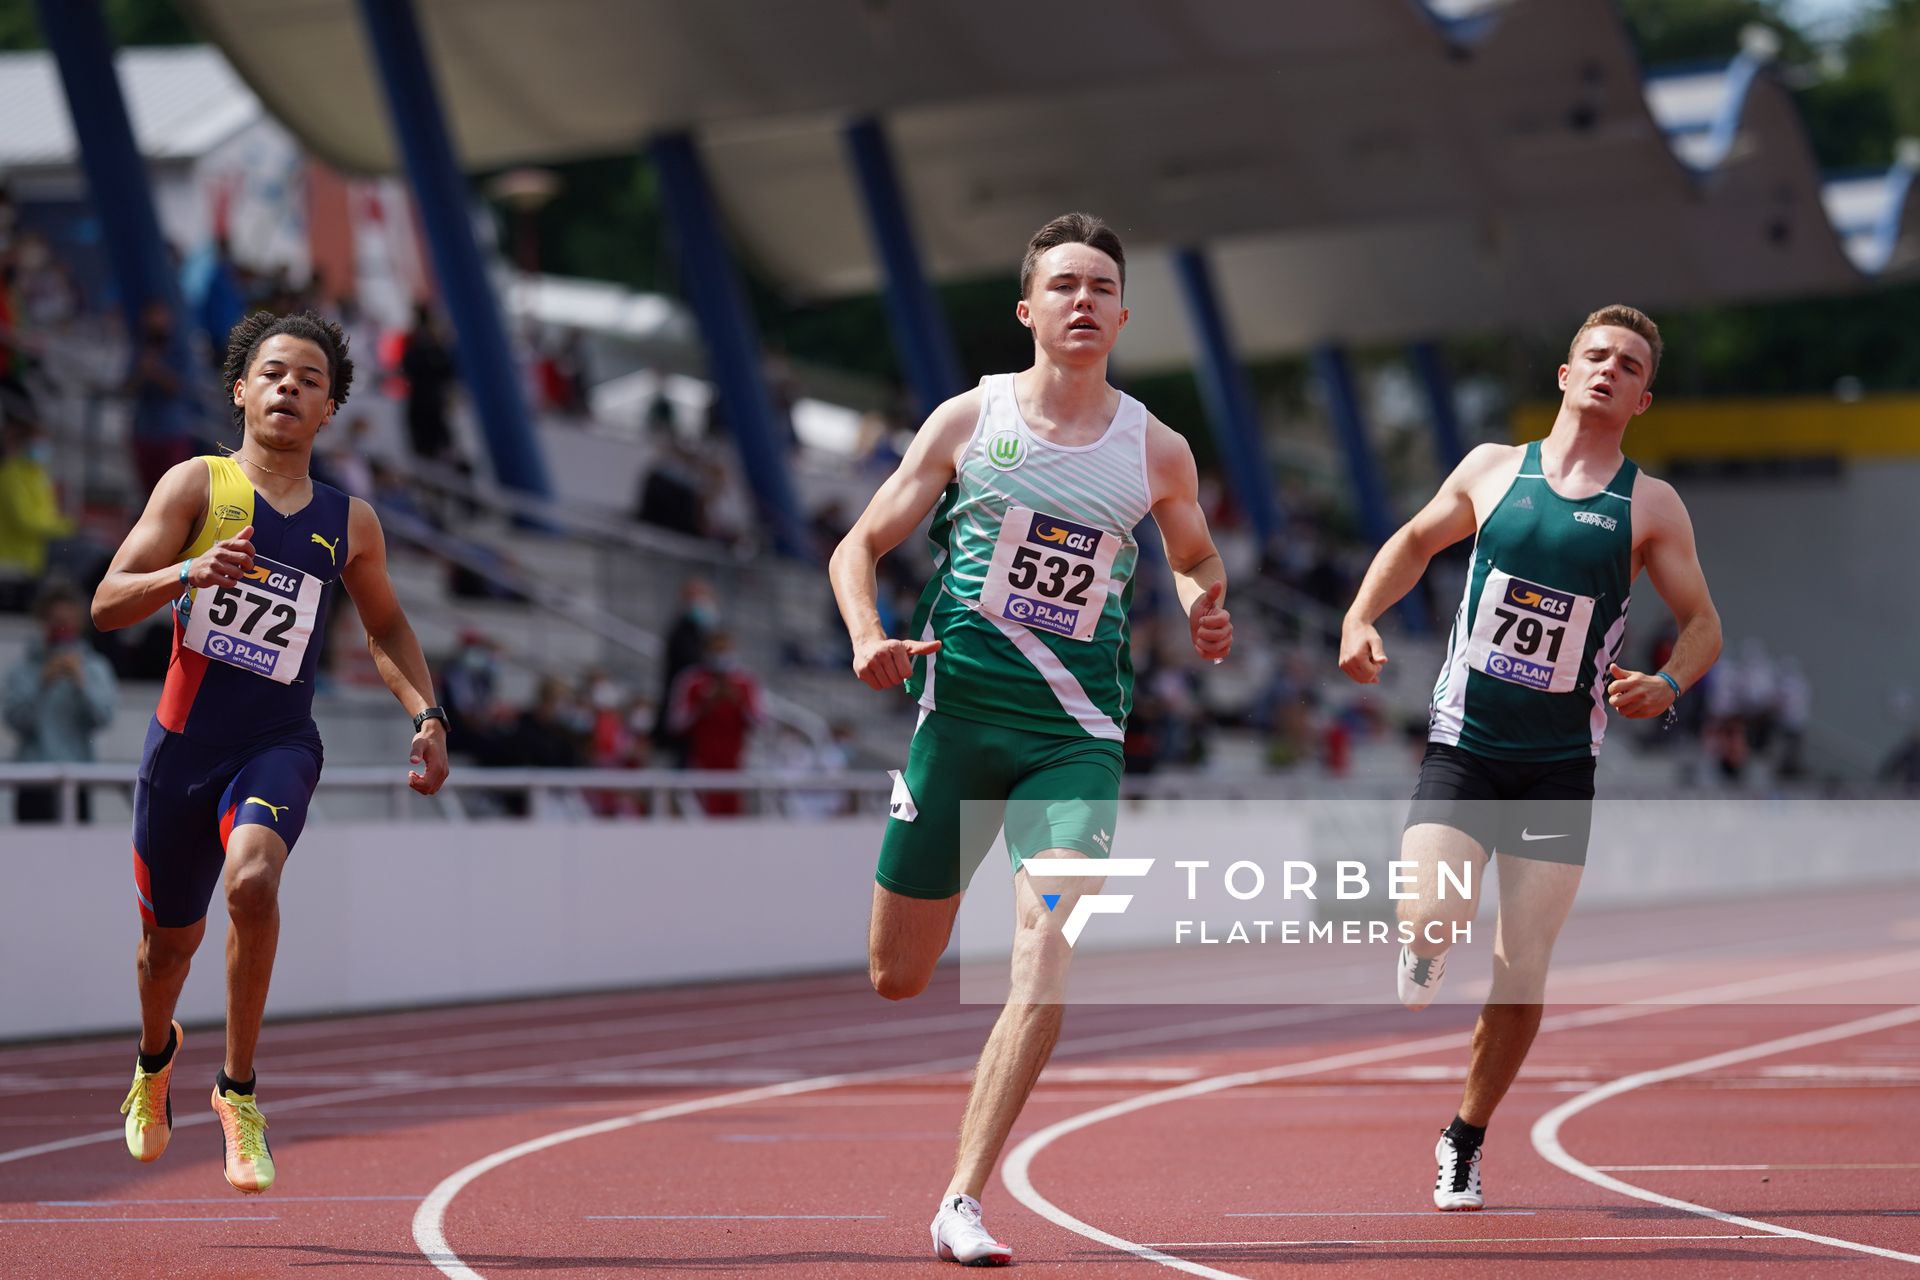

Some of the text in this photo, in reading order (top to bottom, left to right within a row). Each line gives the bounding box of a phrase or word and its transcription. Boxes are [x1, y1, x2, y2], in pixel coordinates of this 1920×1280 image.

[1066, 533, 1095, 552] GLS
[267, 573, 296, 592] GLS
[1008, 545, 1095, 606] 532
[1540, 598, 1568, 615] GLS
[208, 586, 297, 648] 572
[1033, 618, 1071, 632] INTERNATIONAL
[1035, 607, 1075, 627] PLAN
[1492, 607, 1566, 663] 791
[232, 656, 270, 672] INTERNATIONAL
[235, 643, 275, 666] PLAN
[1511, 673, 1547, 687] INTERNATIONAL
[1513, 662, 1551, 681] PLAN
